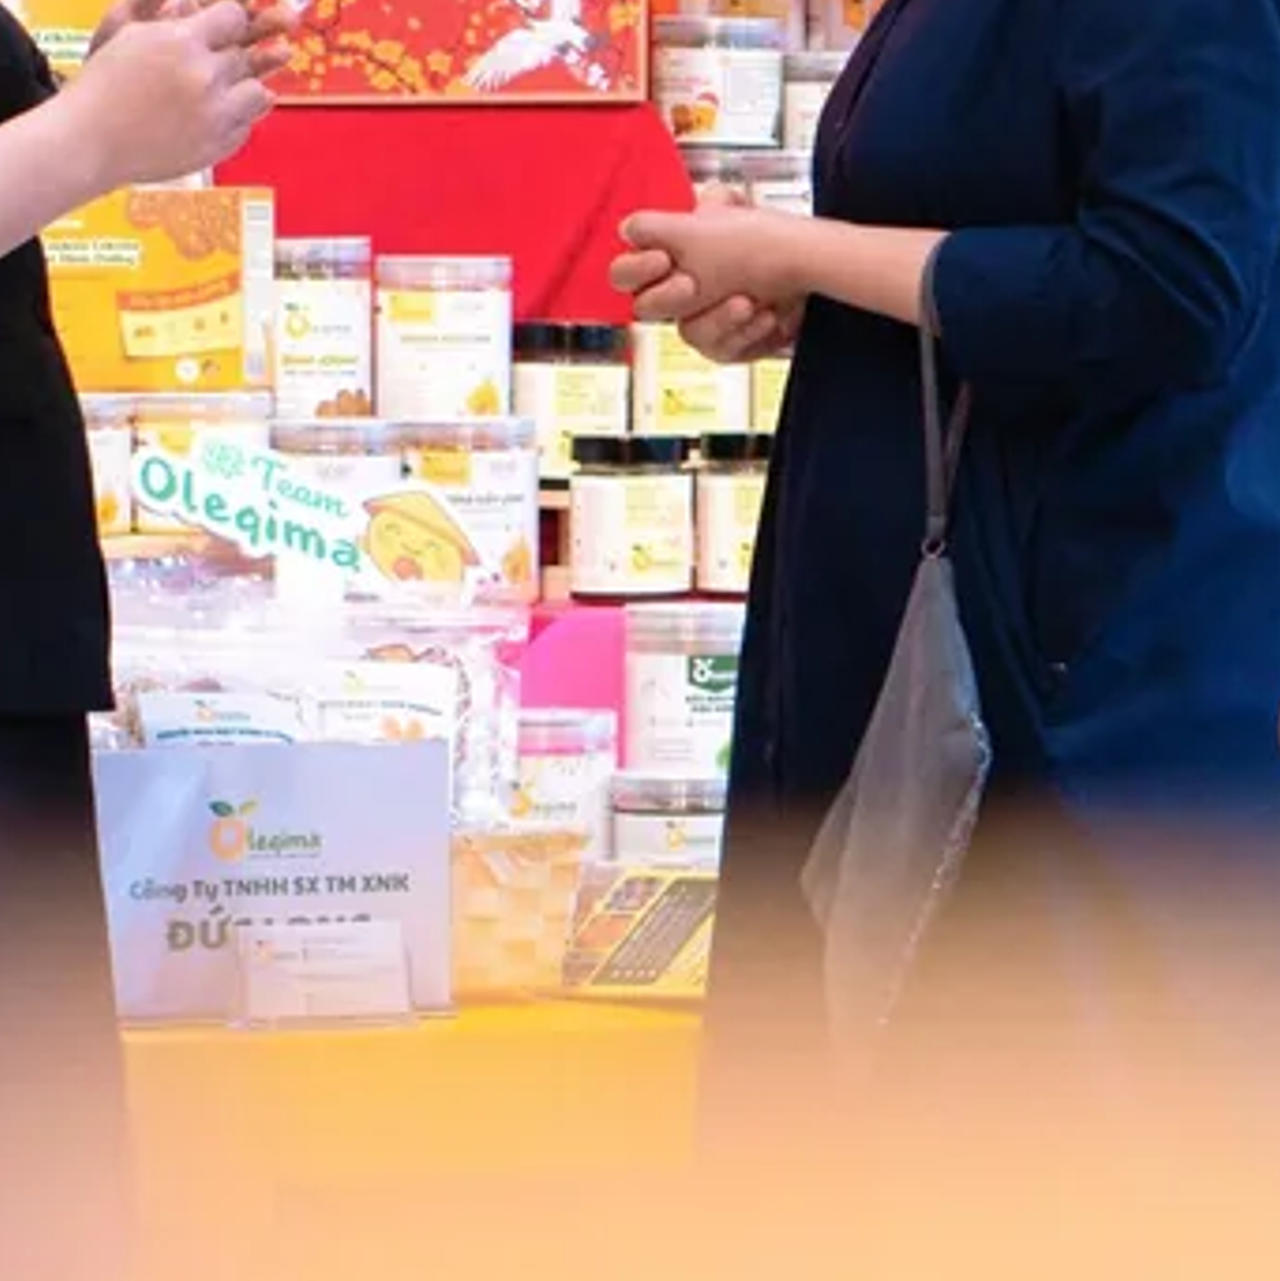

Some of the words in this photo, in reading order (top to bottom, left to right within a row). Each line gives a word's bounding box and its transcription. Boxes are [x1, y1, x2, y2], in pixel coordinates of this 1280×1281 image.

[137, 455, 363, 574] Oleqima
[250, 452, 351, 519] Team
[129, 876, 189, 904] Công
[192, 879, 220, 902] Ty
[224, 877, 289, 898] TNHH
[293, 877, 320, 897] SX
[325, 875, 357, 895] TM
[361, 872, 410, 894] XNK
